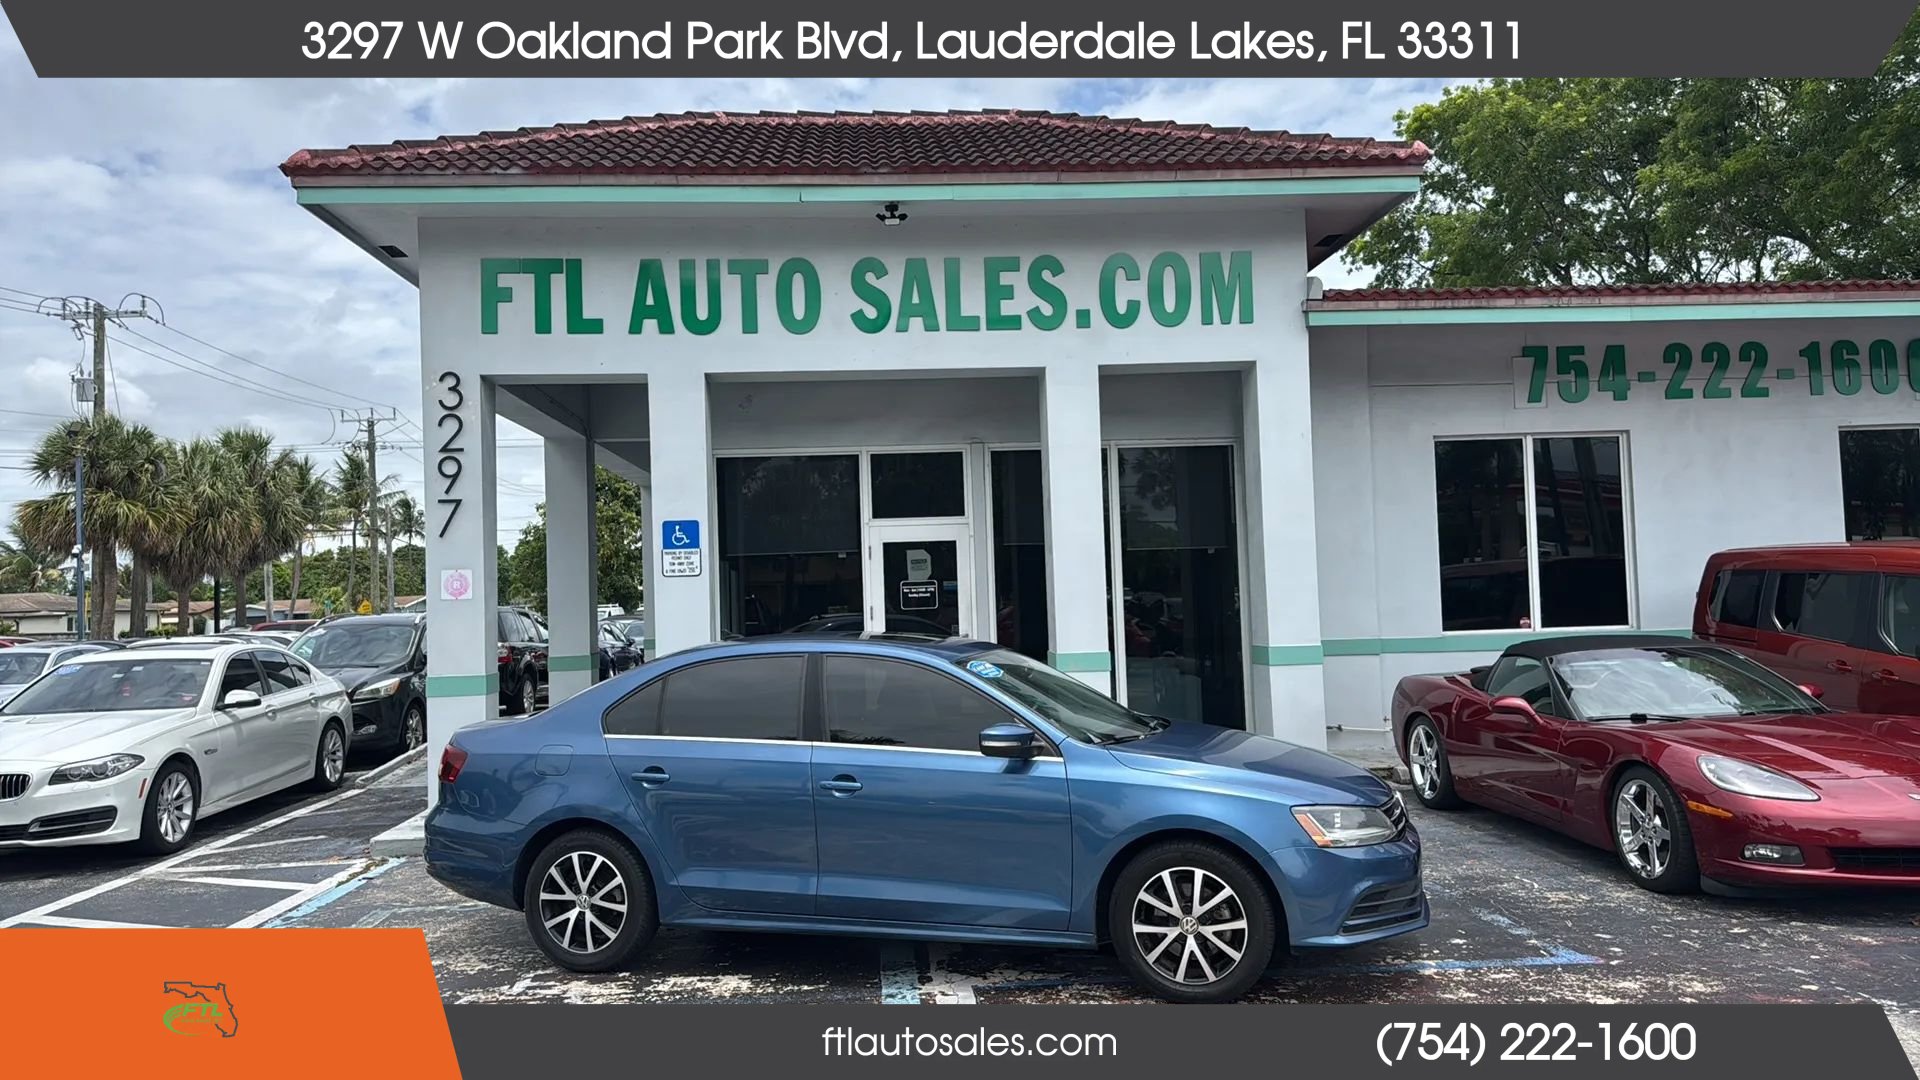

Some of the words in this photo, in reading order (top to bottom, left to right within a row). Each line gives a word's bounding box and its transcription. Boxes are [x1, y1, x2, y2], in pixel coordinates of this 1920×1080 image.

[481, 258, 604, 335] FTL
[629, 257, 821, 336] AUTO
[850, 251, 1255, 334] SALES.COM
[438, 371, 464, 538] 3297
